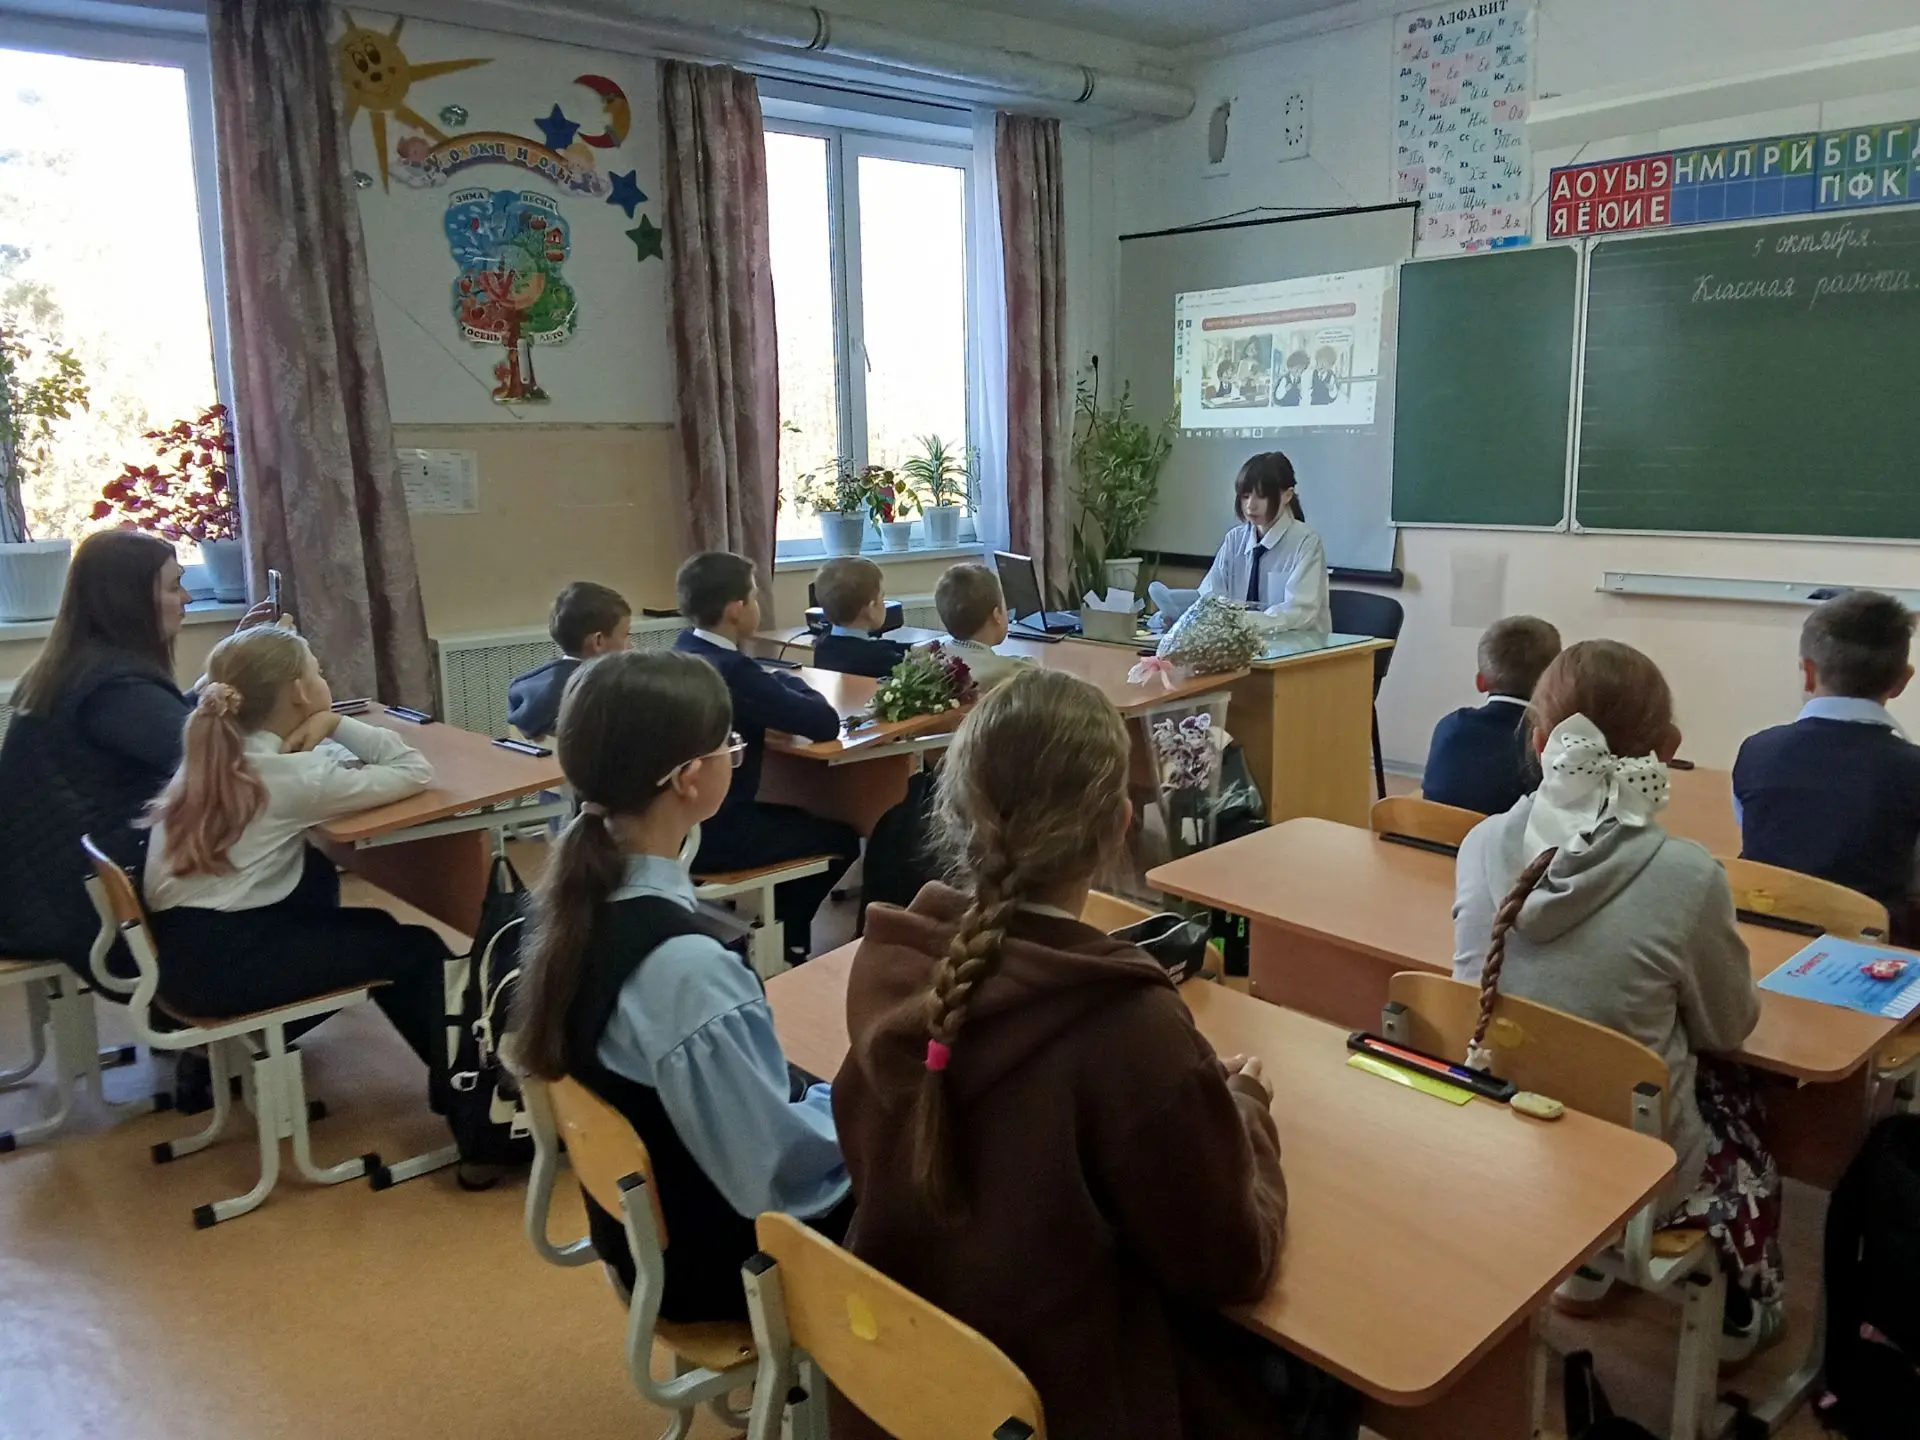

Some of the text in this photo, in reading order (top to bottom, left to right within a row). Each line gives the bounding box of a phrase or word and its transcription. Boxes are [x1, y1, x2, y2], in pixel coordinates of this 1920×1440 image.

[1437, 0, 1508, 27] АЛФАВИТ
[455, 191, 554, 210] ЗИМА ВЕСНА
[1692, 273, 1796, 302] Классная
[466, 327, 564, 342] ОСЕНЬ ЛЕТО
